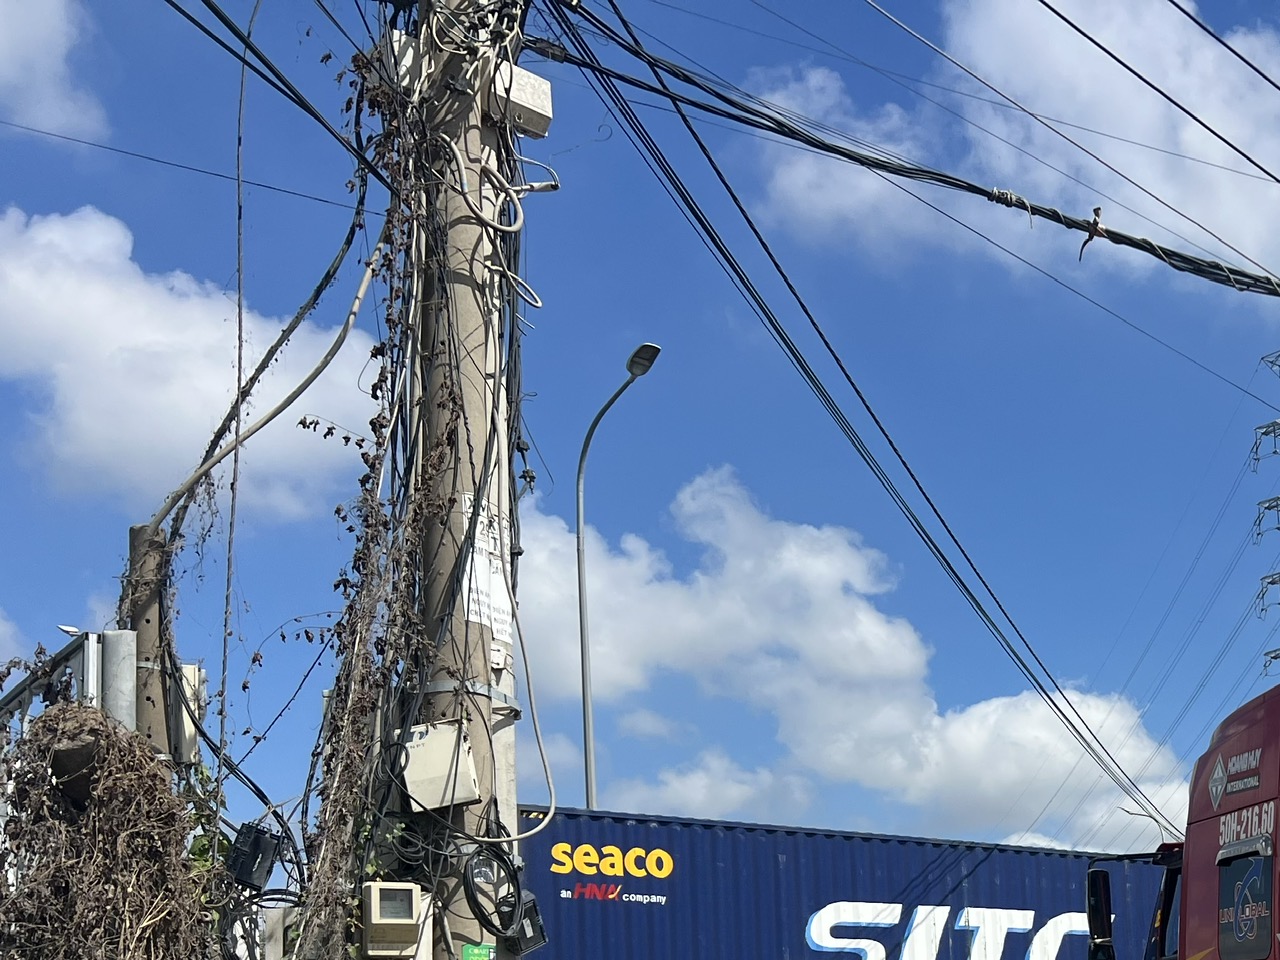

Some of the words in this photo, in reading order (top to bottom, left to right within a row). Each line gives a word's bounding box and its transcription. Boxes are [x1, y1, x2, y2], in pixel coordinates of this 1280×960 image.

[1219, 801, 1275, 846] 50H-216.60
[549, 842, 674, 879] seaco
[560, 889, 572, 899] an
[573, 883, 622, 901] HNA
[622, 893, 667, 905] company
